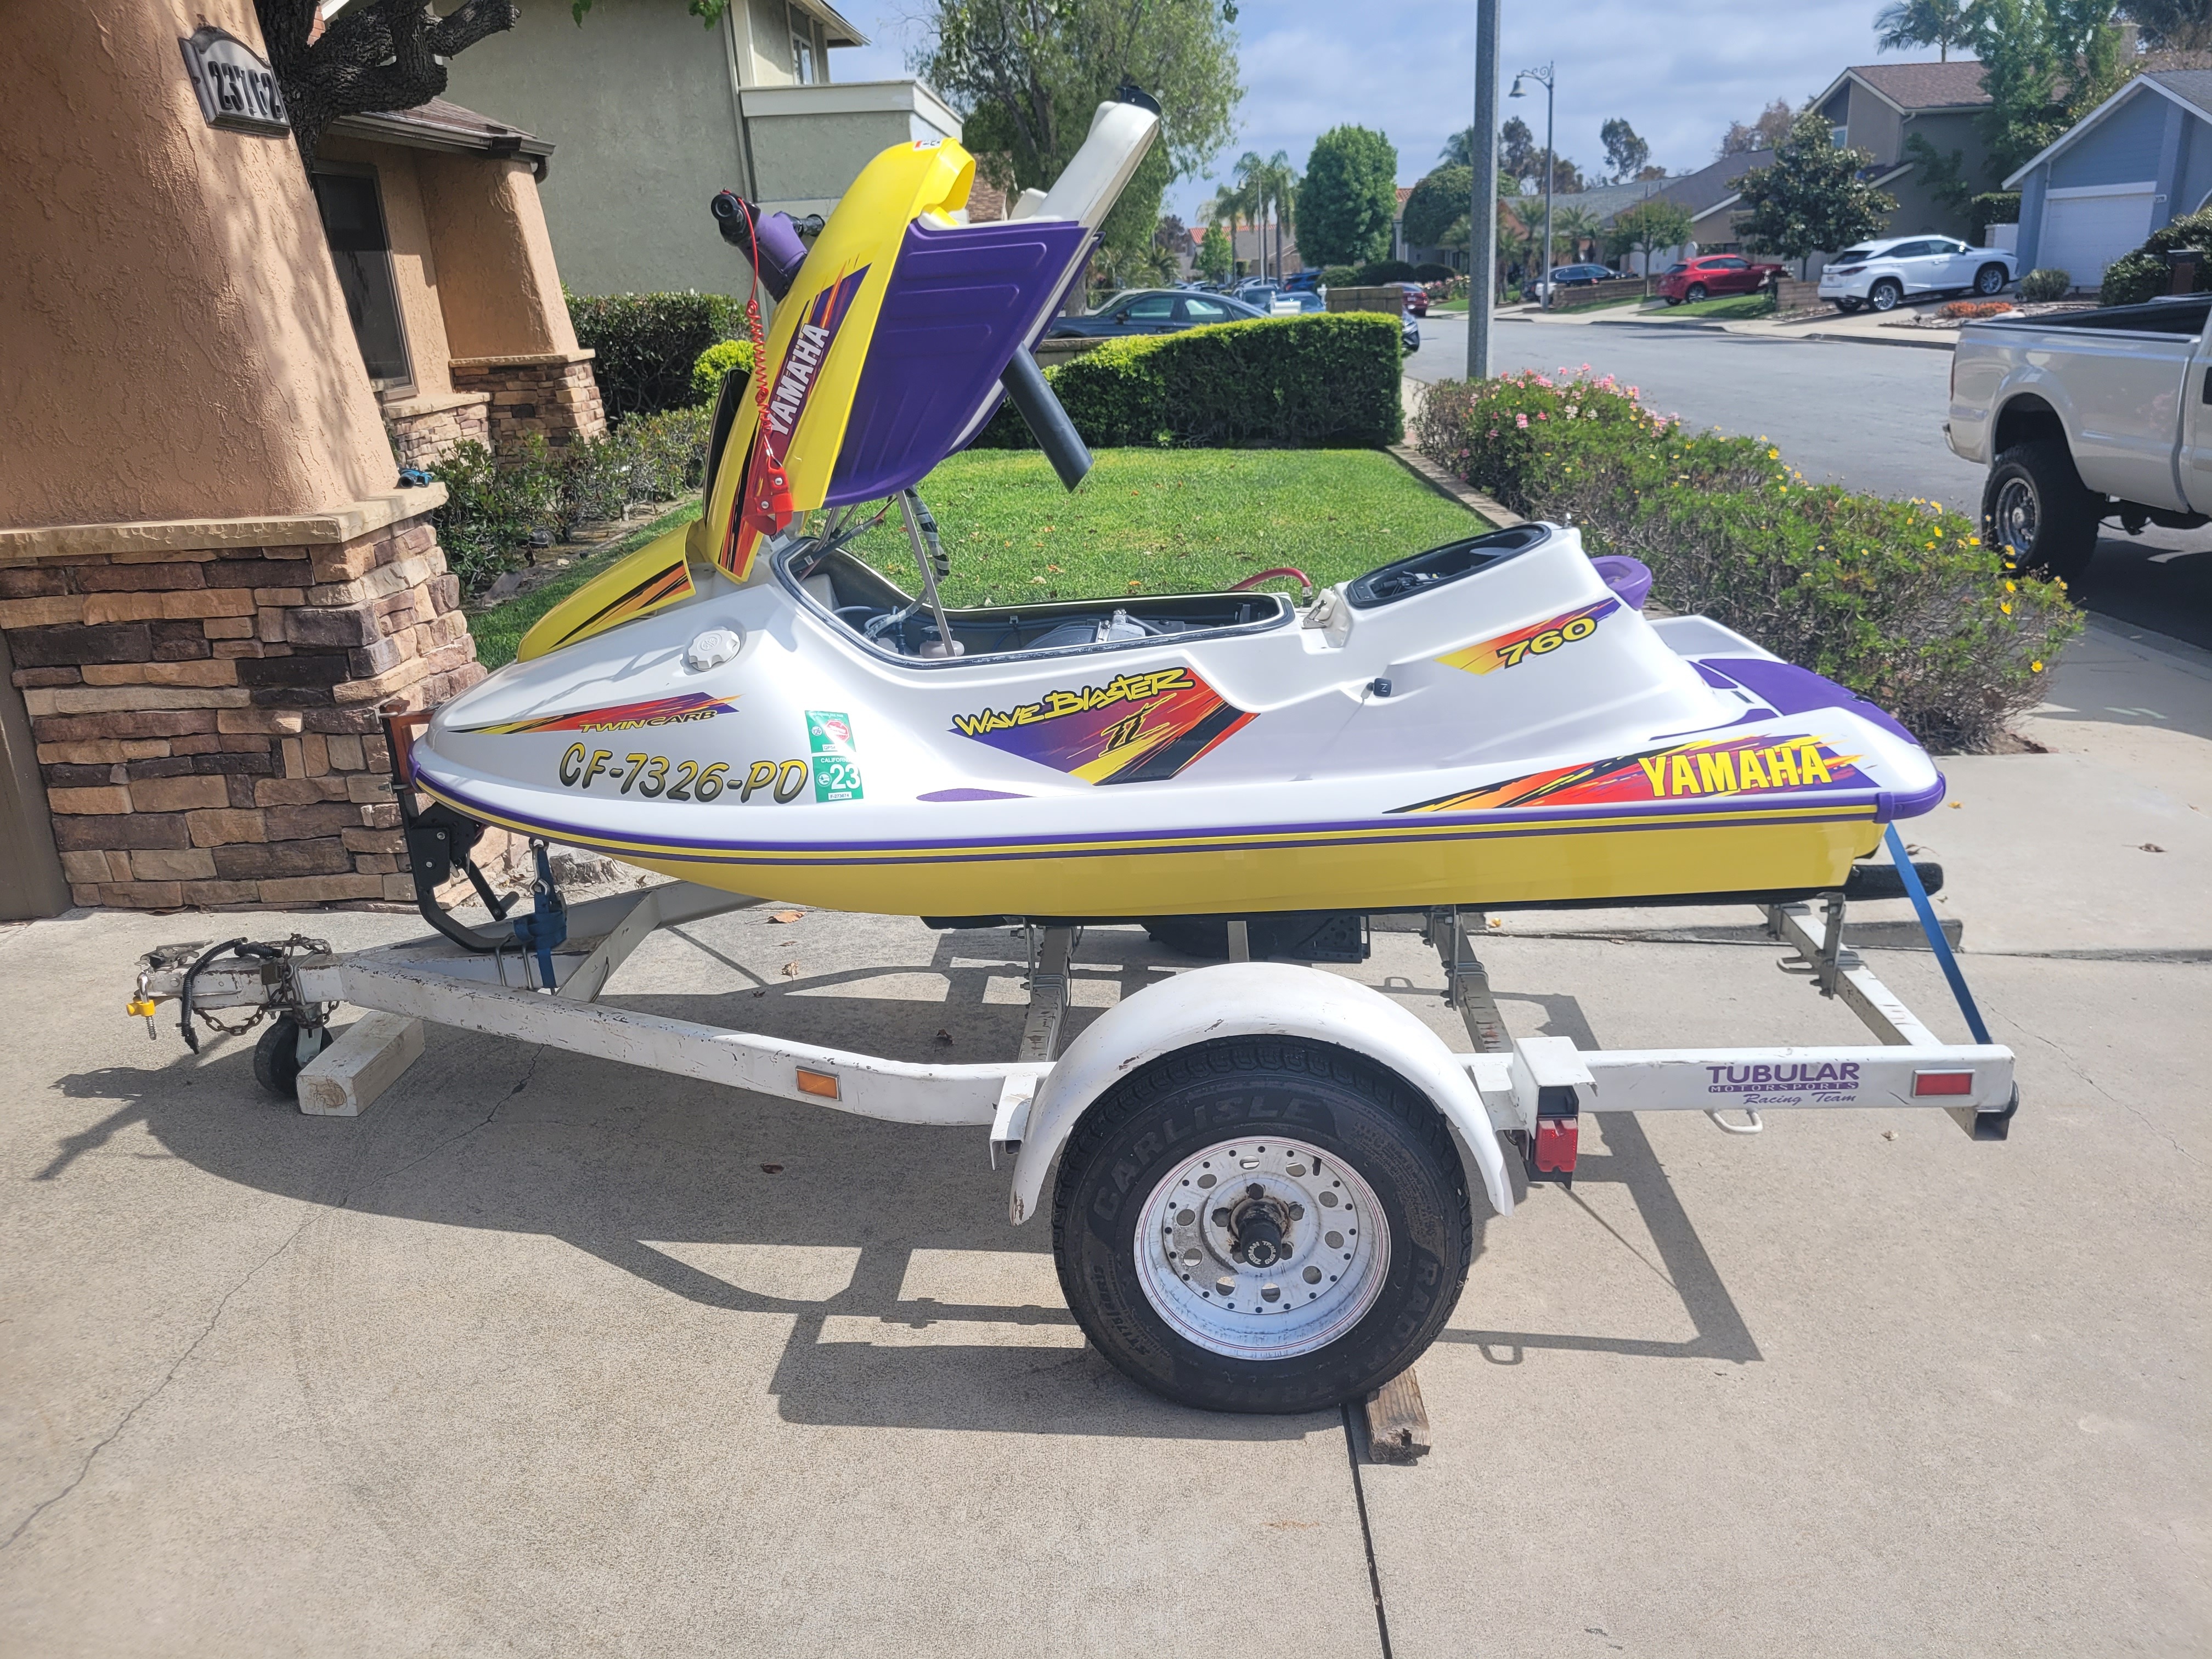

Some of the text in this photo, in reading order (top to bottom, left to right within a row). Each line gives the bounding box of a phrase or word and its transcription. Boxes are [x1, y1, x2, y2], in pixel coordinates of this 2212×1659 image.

[768, 323, 830, 436] YAMAHA
[1496, 616, 1598, 669] 760
[830, 764, 861, 789] 23
[1637, 744, 1833, 797] YAMAHA
[1706, 1062, 1860, 1084] TUBULAR
[1709, 1081, 1858, 1093] MOTORSPORTS
[1743, 1091, 1857, 1106] Racing Team
[1093, 1096, 1316, 1221] CARLISLE
[1262, 1240, 1277, 1265] TRAILERS
